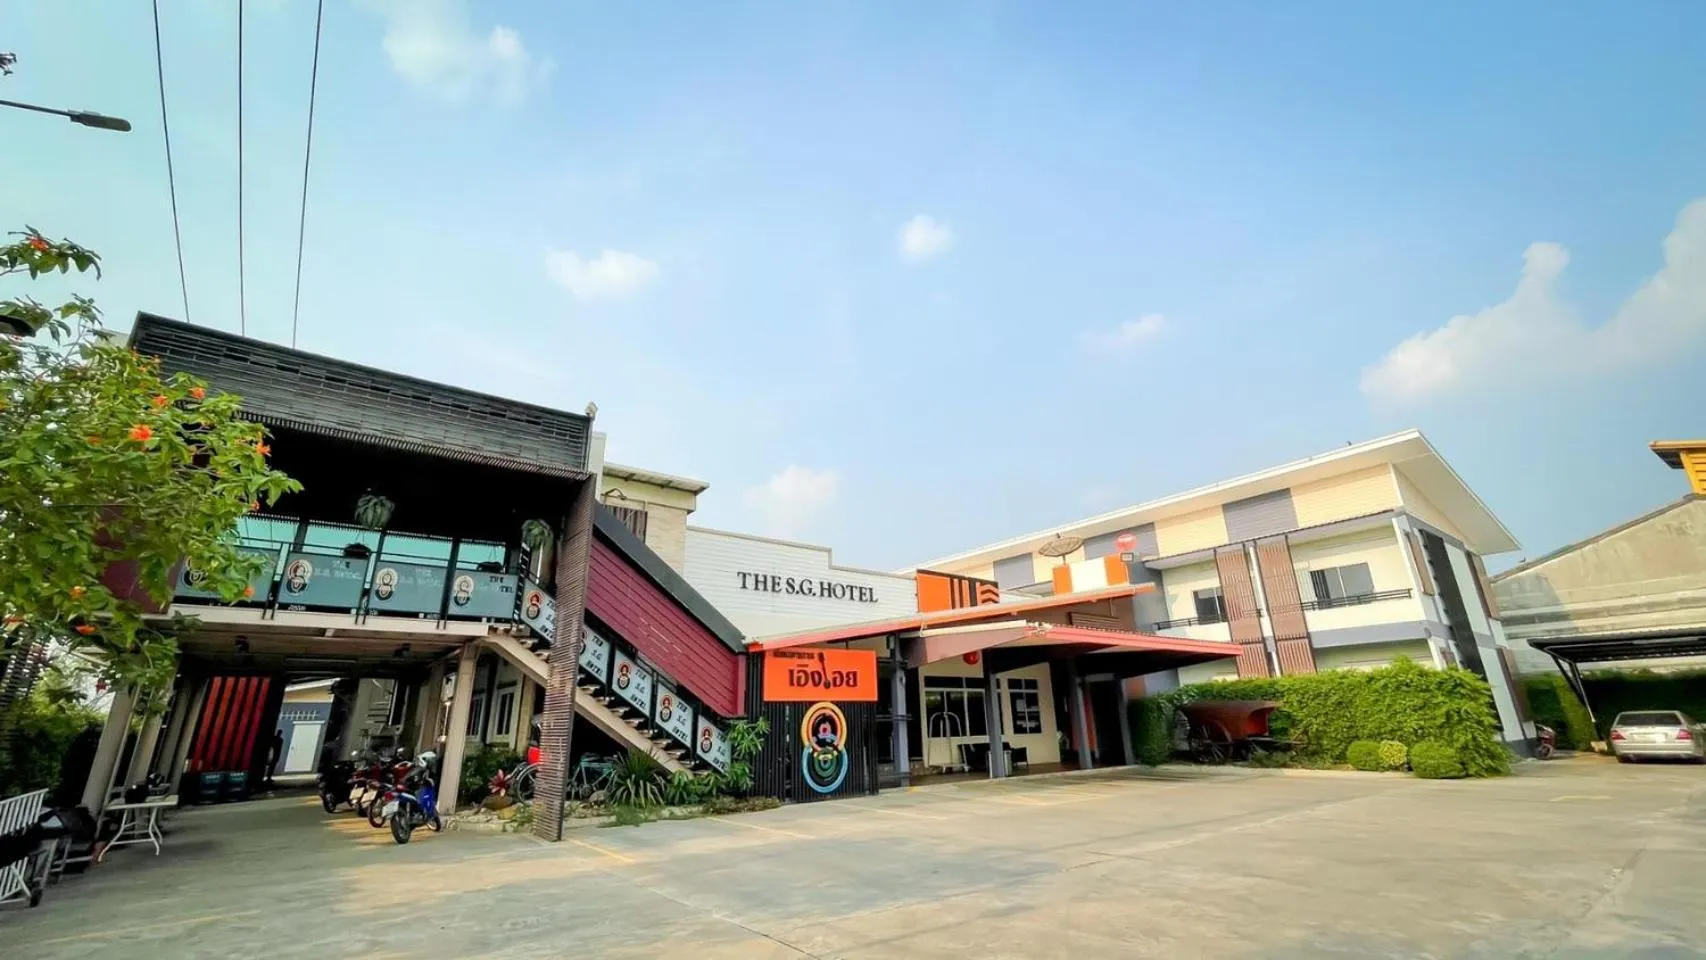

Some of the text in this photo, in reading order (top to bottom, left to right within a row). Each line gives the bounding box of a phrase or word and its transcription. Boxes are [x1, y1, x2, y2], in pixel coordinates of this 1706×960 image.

[737, 571, 879, 603] THE S.G. HOTEL
